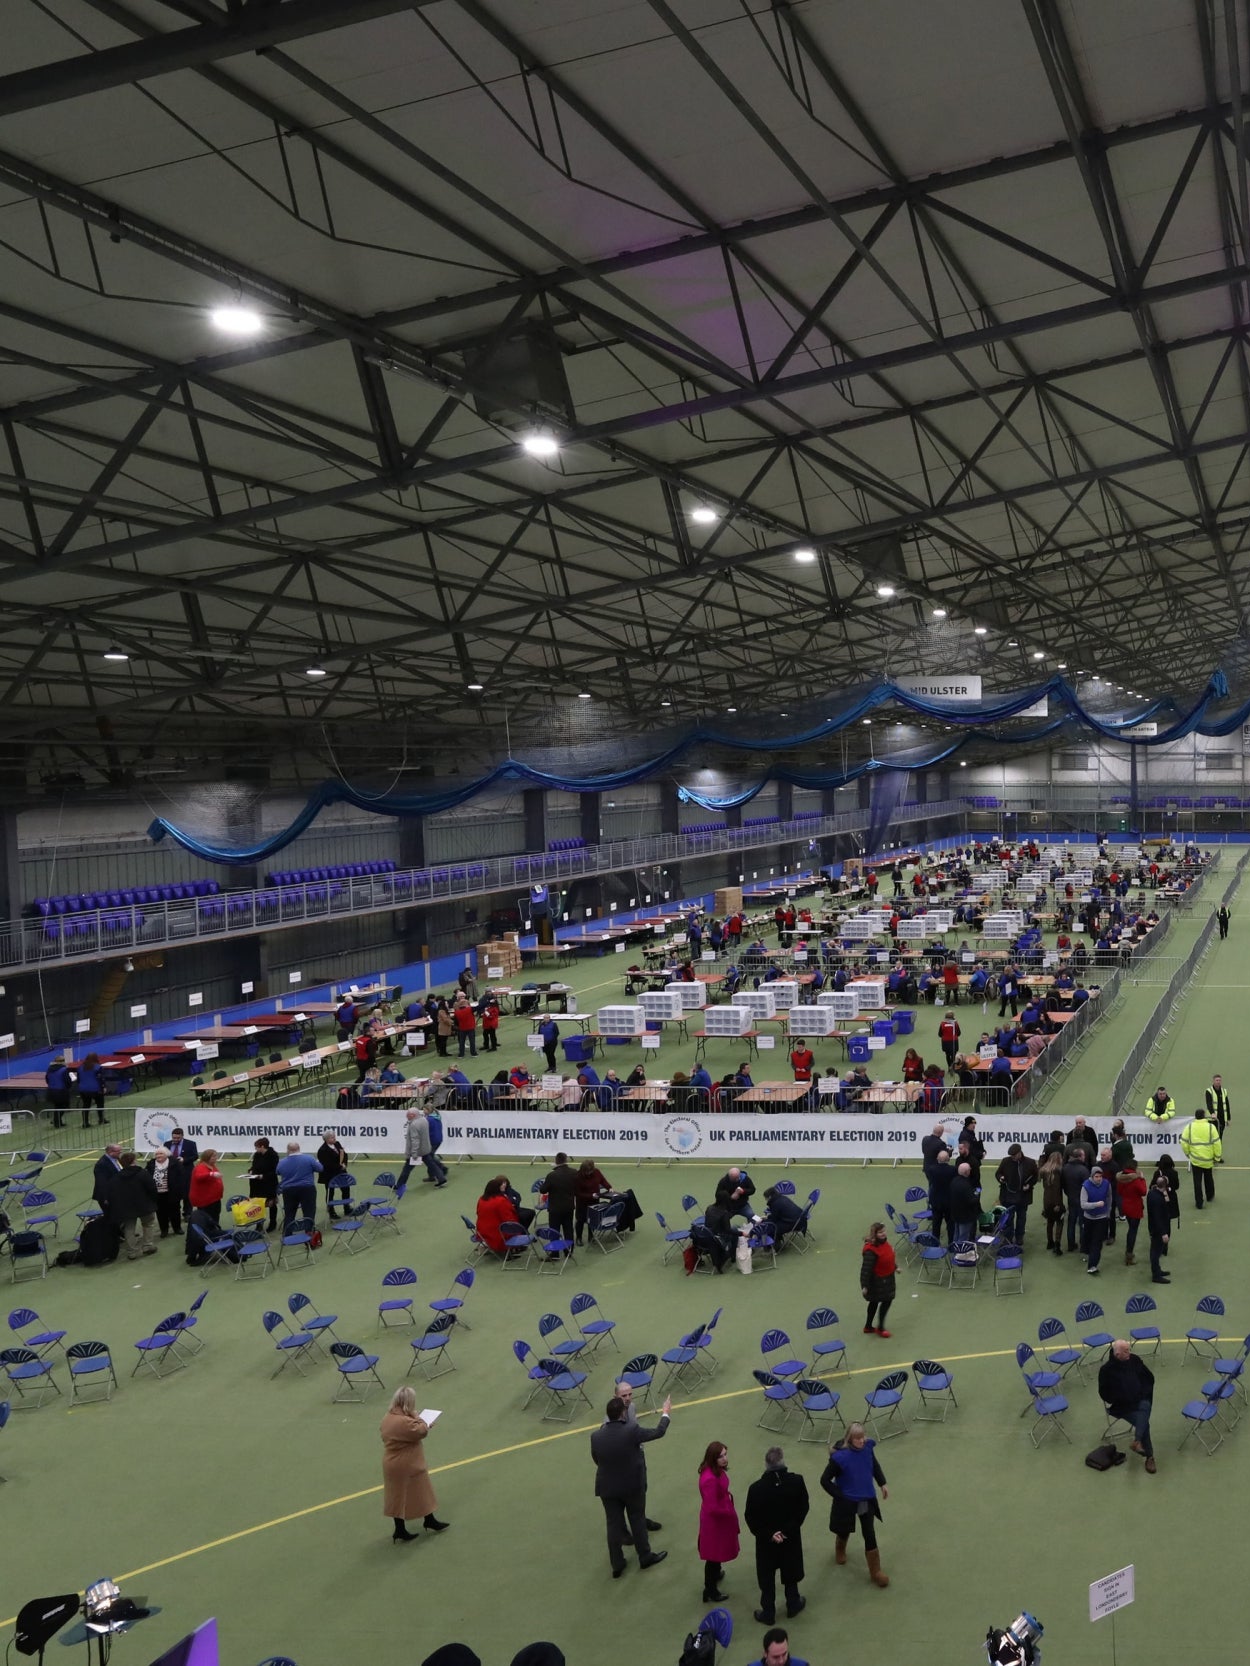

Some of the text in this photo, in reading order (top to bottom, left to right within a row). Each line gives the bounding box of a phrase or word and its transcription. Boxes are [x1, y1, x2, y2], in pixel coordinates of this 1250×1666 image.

[930, 686, 968, 694] ULSTER
[188, 1126, 203, 1136] UK
[207, 1125, 300, 1136] PARLIAMENTARY
[360, 1126, 388, 1137] 2019
[448, 1127, 648, 1141] UK PARLIAMENTARY ELECTION 2019
[709, 1130, 916, 1141] UK PARLIAMENTARY ELECTION 2019
[979, 1132, 994, 1142] UK
[1098, 1134, 1152, 1144] ELTION
[1098, 1572, 1125, 1588] CANDIDATES
[1106, 1590, 1117, 1598] EAST
[1096, 1592, 1128, 1610] LONDONDERRY
